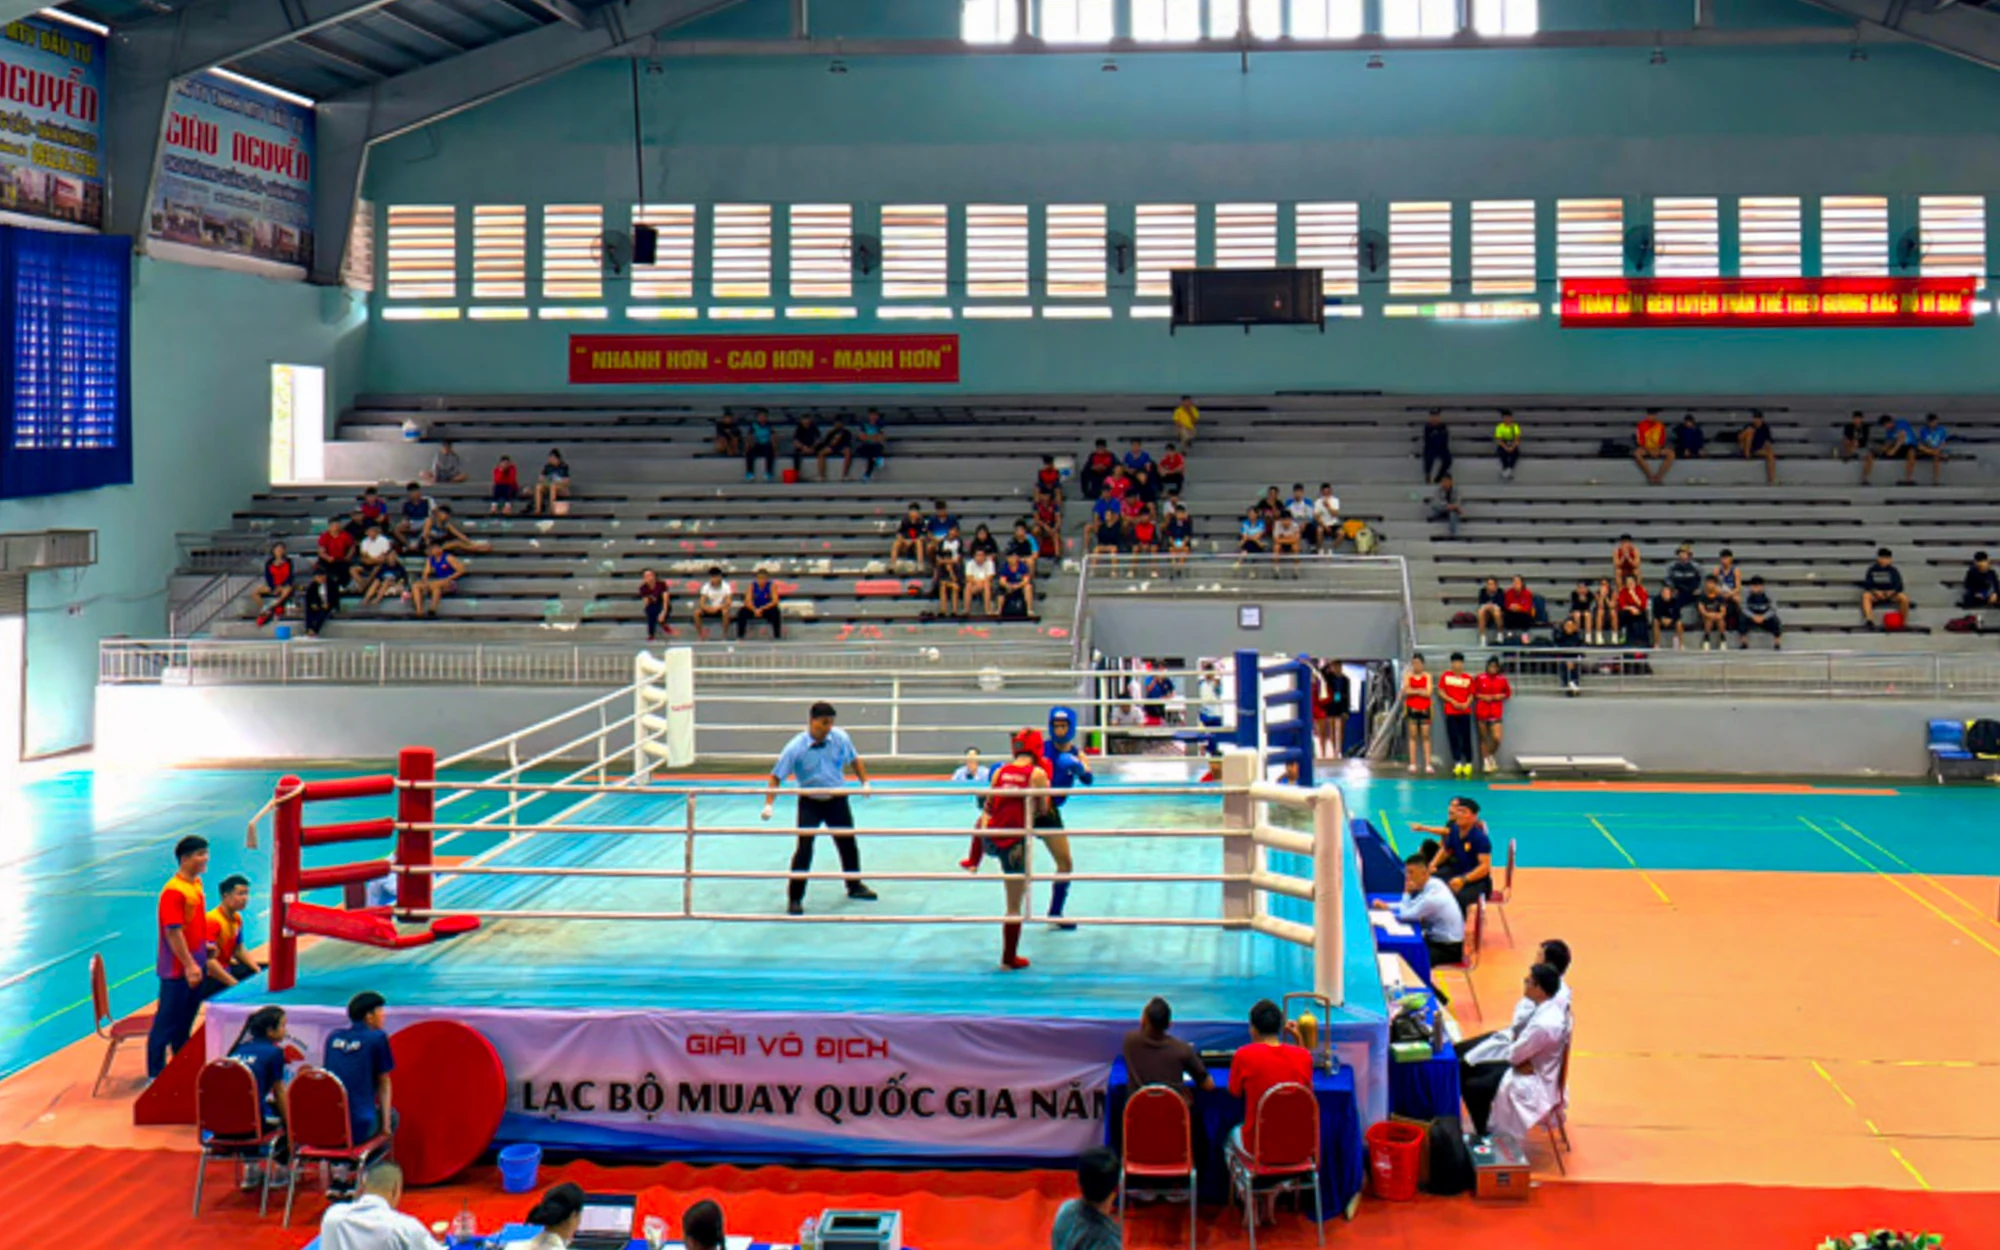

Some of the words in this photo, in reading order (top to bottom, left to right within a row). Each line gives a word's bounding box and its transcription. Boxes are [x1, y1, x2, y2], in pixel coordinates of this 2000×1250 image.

[232, 131, 310, 181] NGUYỄN
[592, 350, 661, 370] NHANH
[666, 349, 708, 370] HƠN
[727, 350, 767, 370] CAO
[772, 349, 814, 370] HƠN
[833, 350, 893, 372] MẠNH
[686, 1029, 746, 1056] GIẢI
[815, 1037, 888, 1063] ĐỊCH
[522, 1080, 597, 1121] LẠC
[608, 1071, 665, 1121] BỘ
[677, 1081, 802, 1114] MUAY
[813, 1072, 937, 1124] QUỐC
[945, 1086, 1018, 1119] GIA
